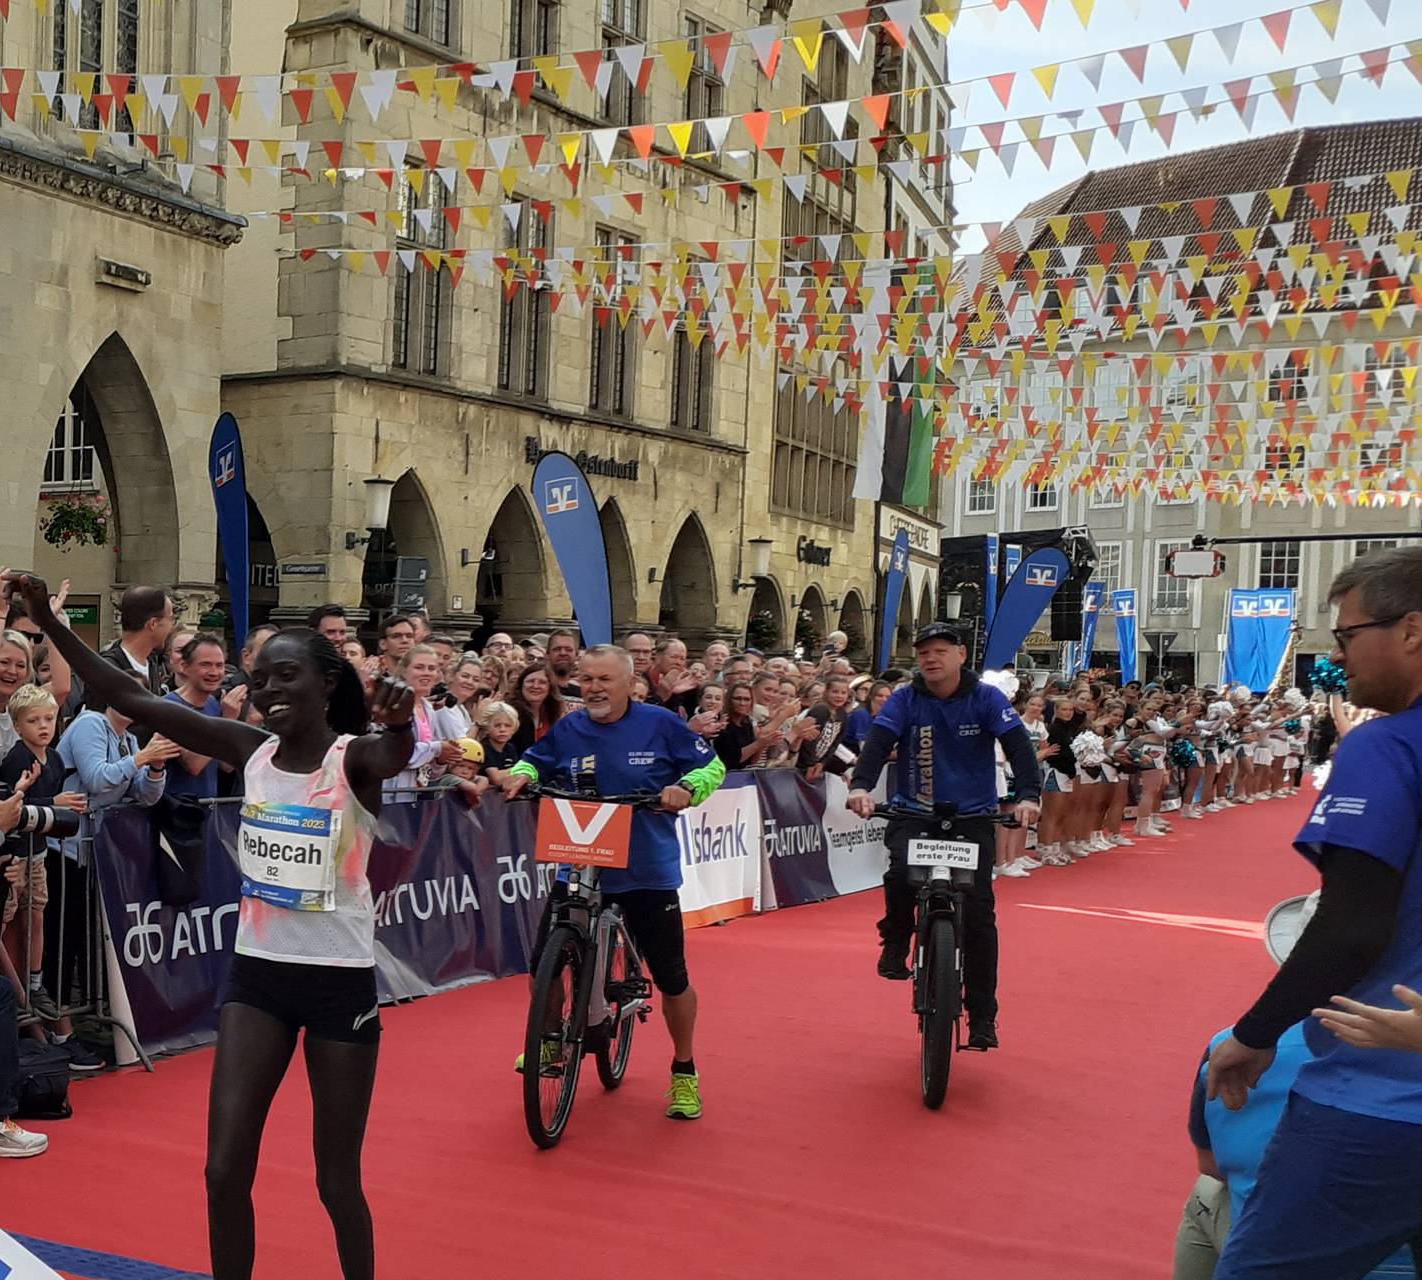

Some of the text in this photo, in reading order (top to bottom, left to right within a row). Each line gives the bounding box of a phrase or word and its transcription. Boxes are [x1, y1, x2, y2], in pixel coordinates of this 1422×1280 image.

[257, 811, 299, 828] Marathon
[300, 818, 327, 830] 2023
[242, 829, 322, 866] Rebecah
[778, 823, 822, 857] ATRUVIA
[827, 823, 865, 853] Teamgeist
[916, 842, 971, 855] Begleitung
[916, 852, 970, 863] erste Frau
[266, 865, 279, 877] 82
